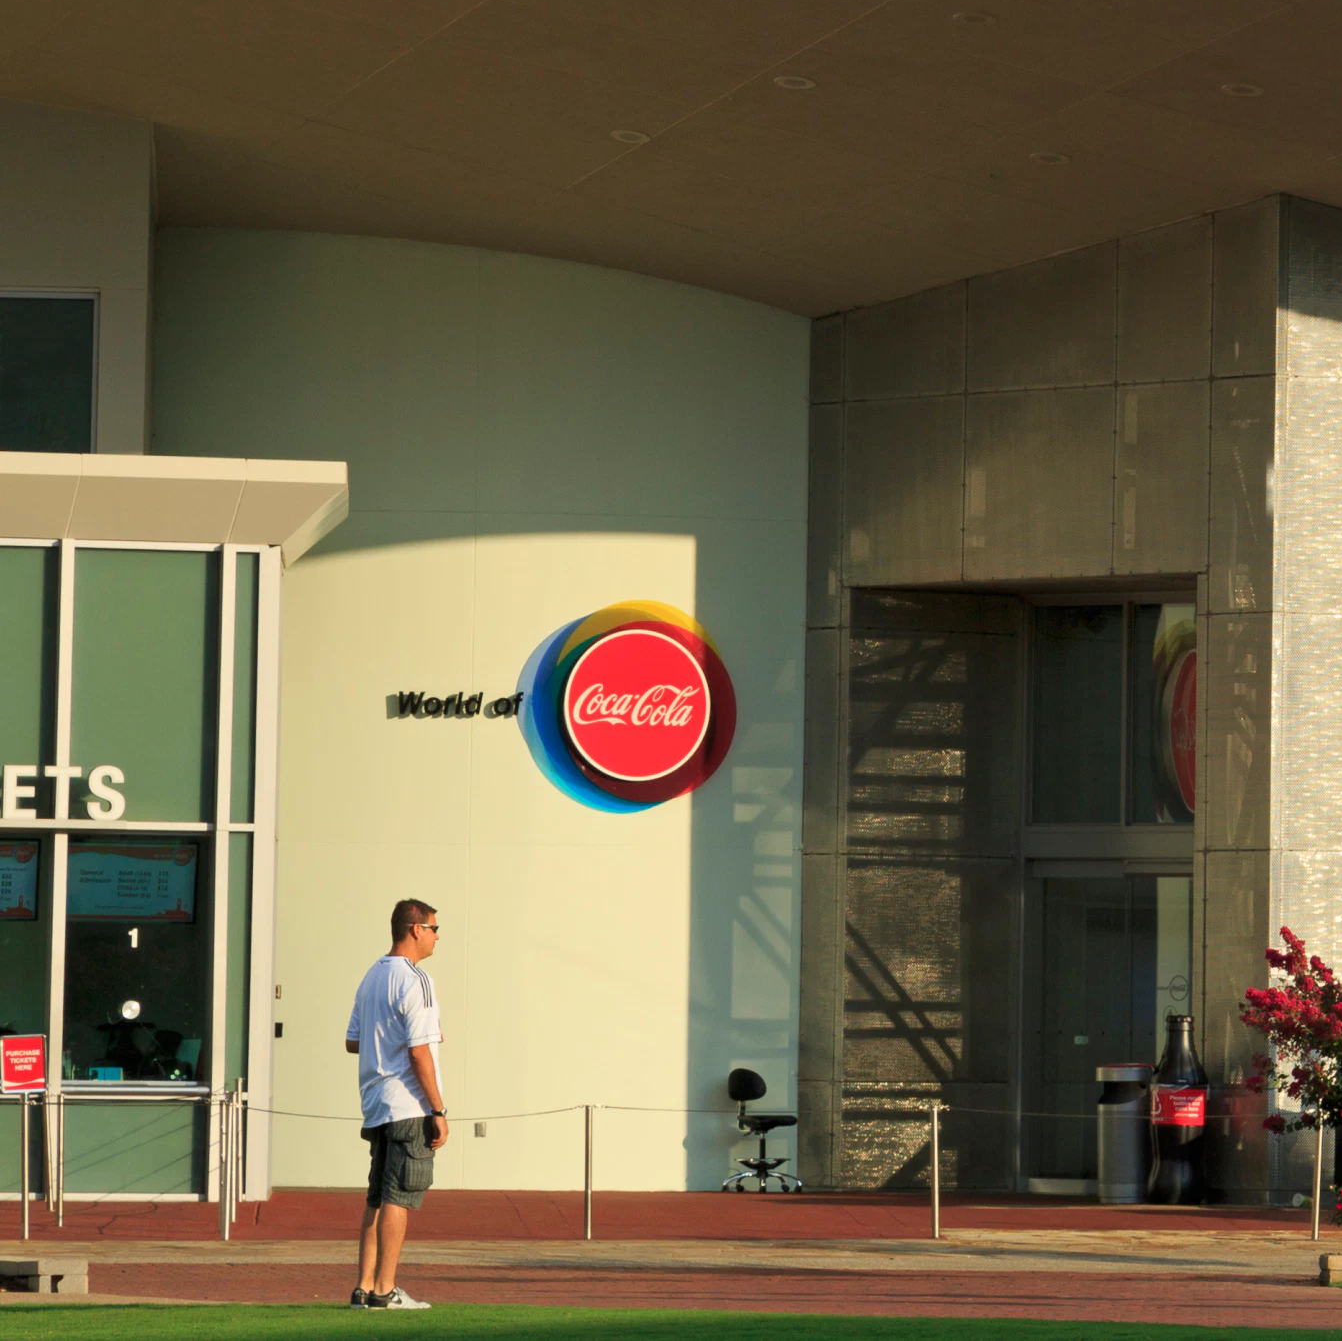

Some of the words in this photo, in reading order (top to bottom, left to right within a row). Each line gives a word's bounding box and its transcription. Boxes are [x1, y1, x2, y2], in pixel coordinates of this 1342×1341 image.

[397, 691, 484, 716] World
[493, 691, 524, 716] of
[127, 928, 139, 949] 1
